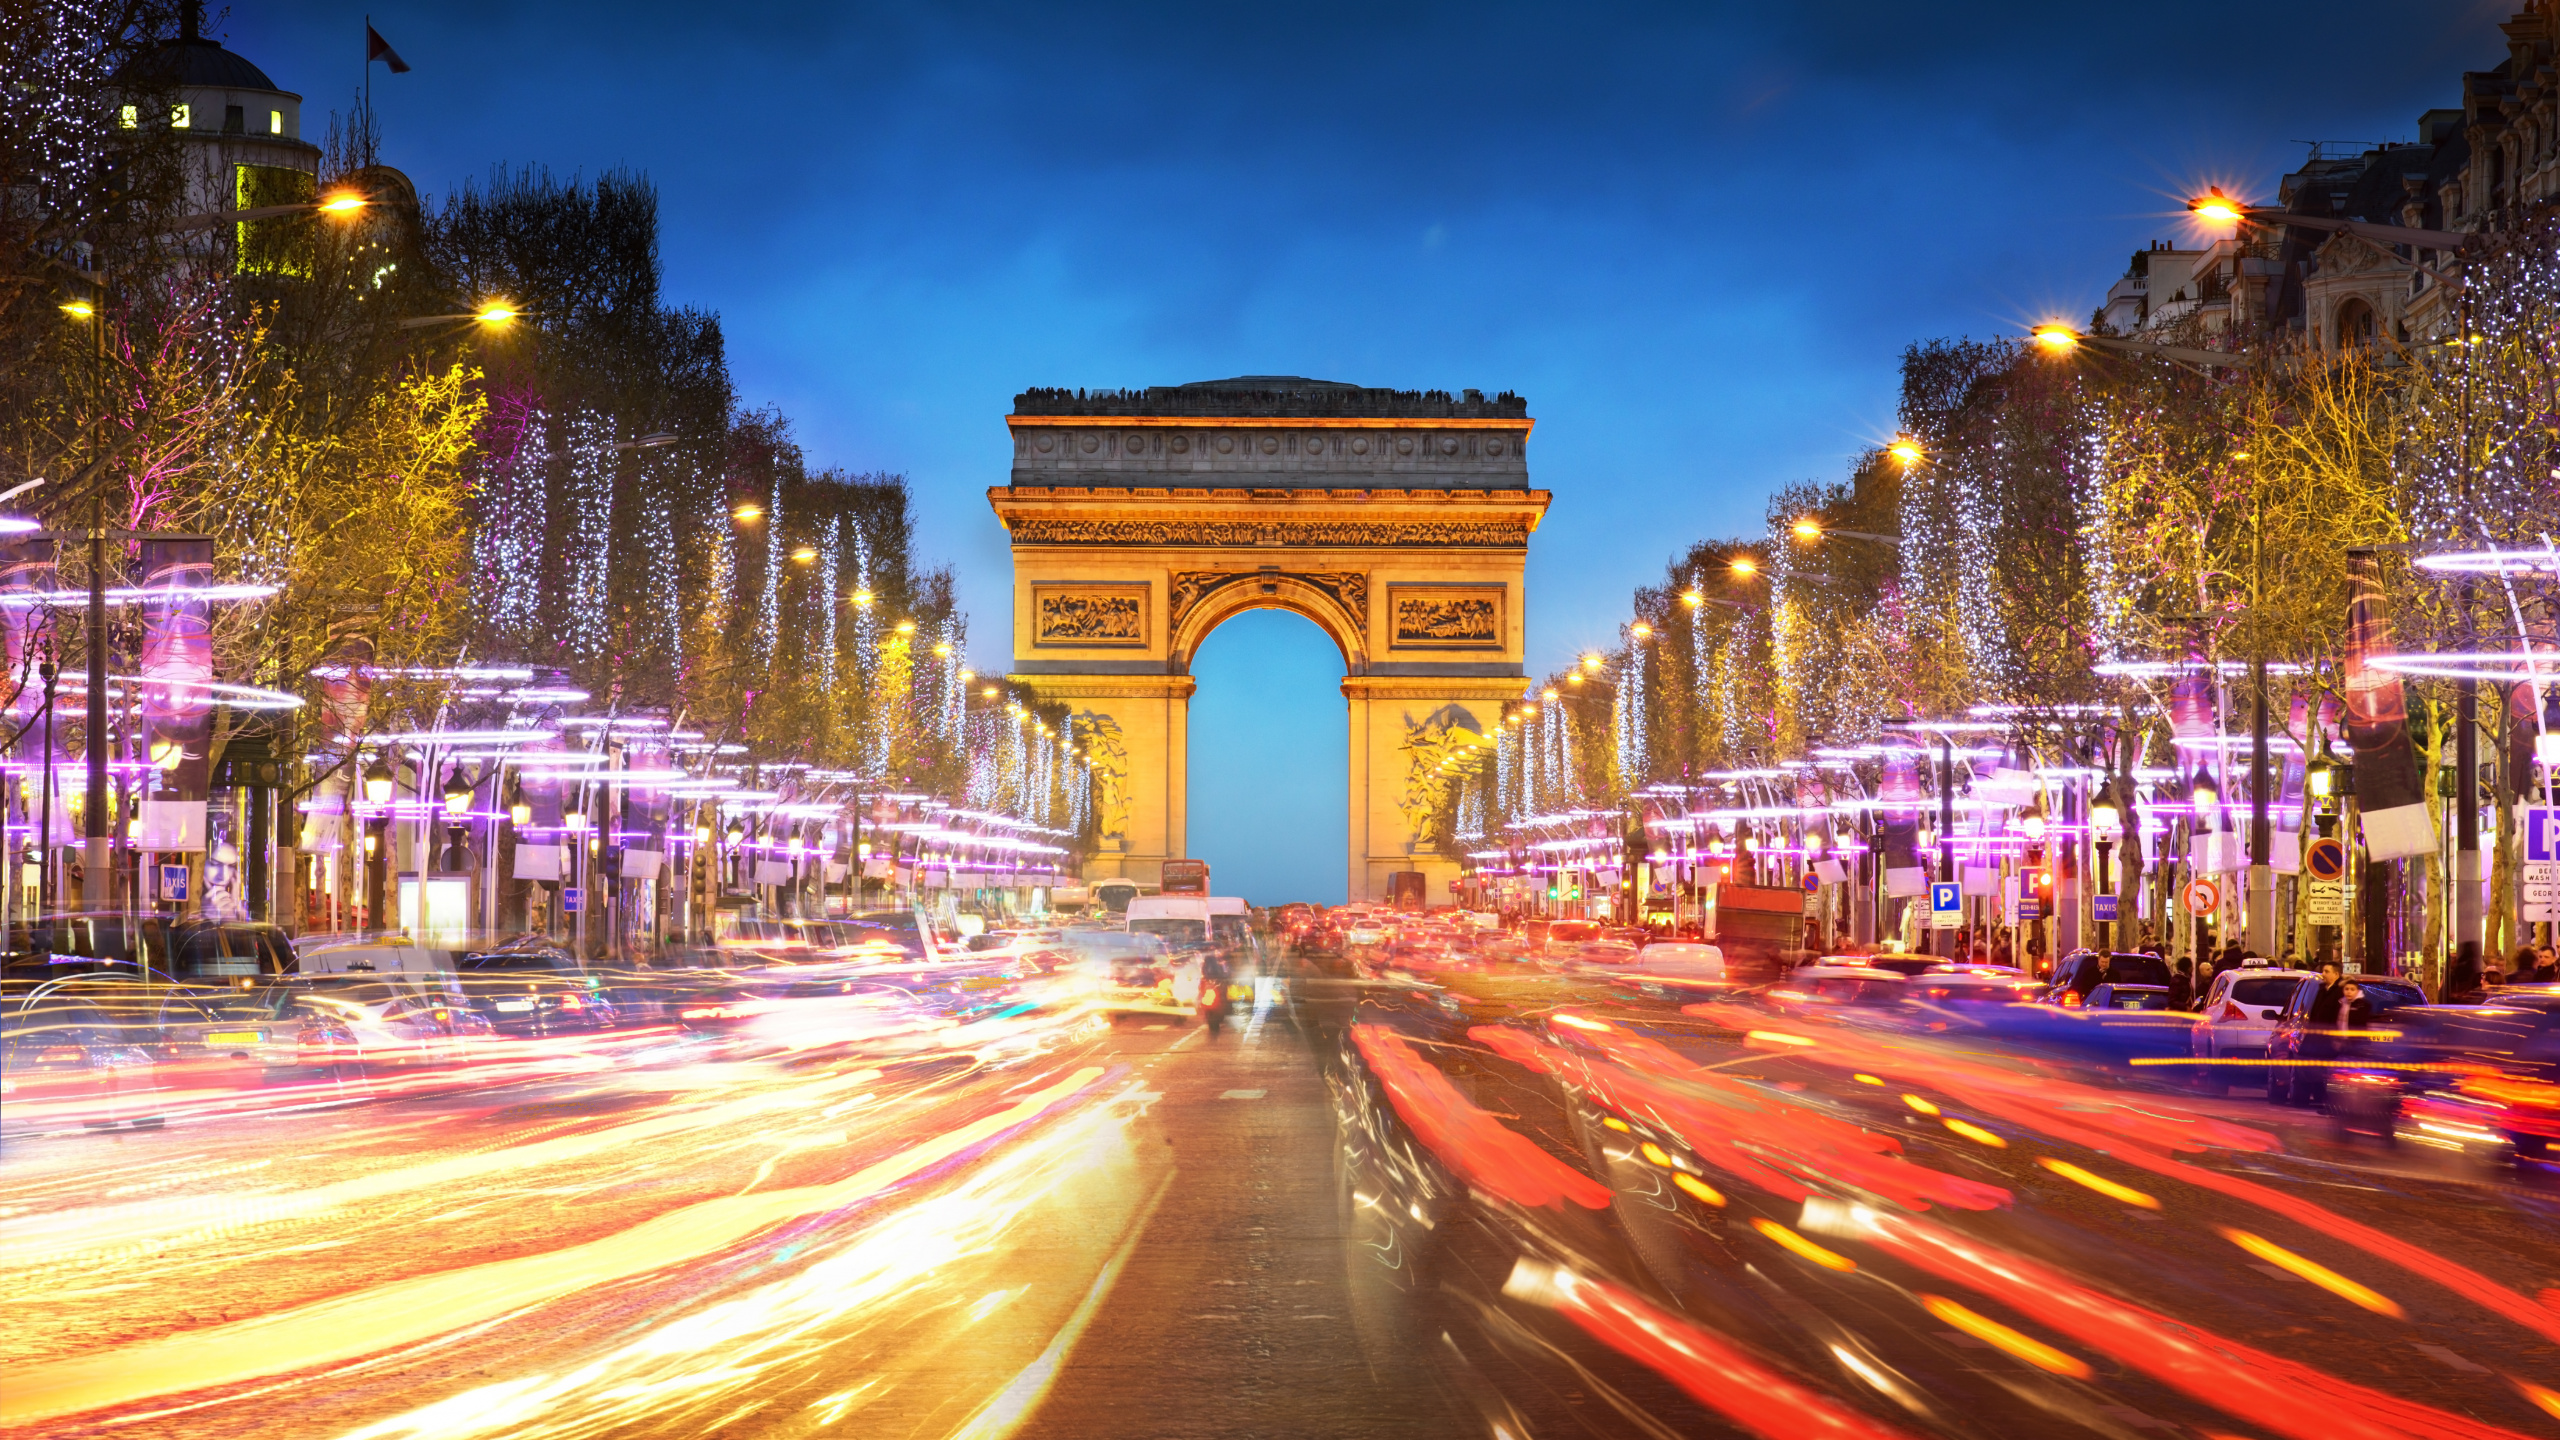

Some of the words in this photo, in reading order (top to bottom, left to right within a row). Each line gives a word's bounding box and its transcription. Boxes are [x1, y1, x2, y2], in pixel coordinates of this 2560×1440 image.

[165, 878, 186, 888] TAXIS
[2029, 873, 2039, 893] P
[1940, 888, 1953, 907] P
[2095, 903, 2117, 911] TAXIS
